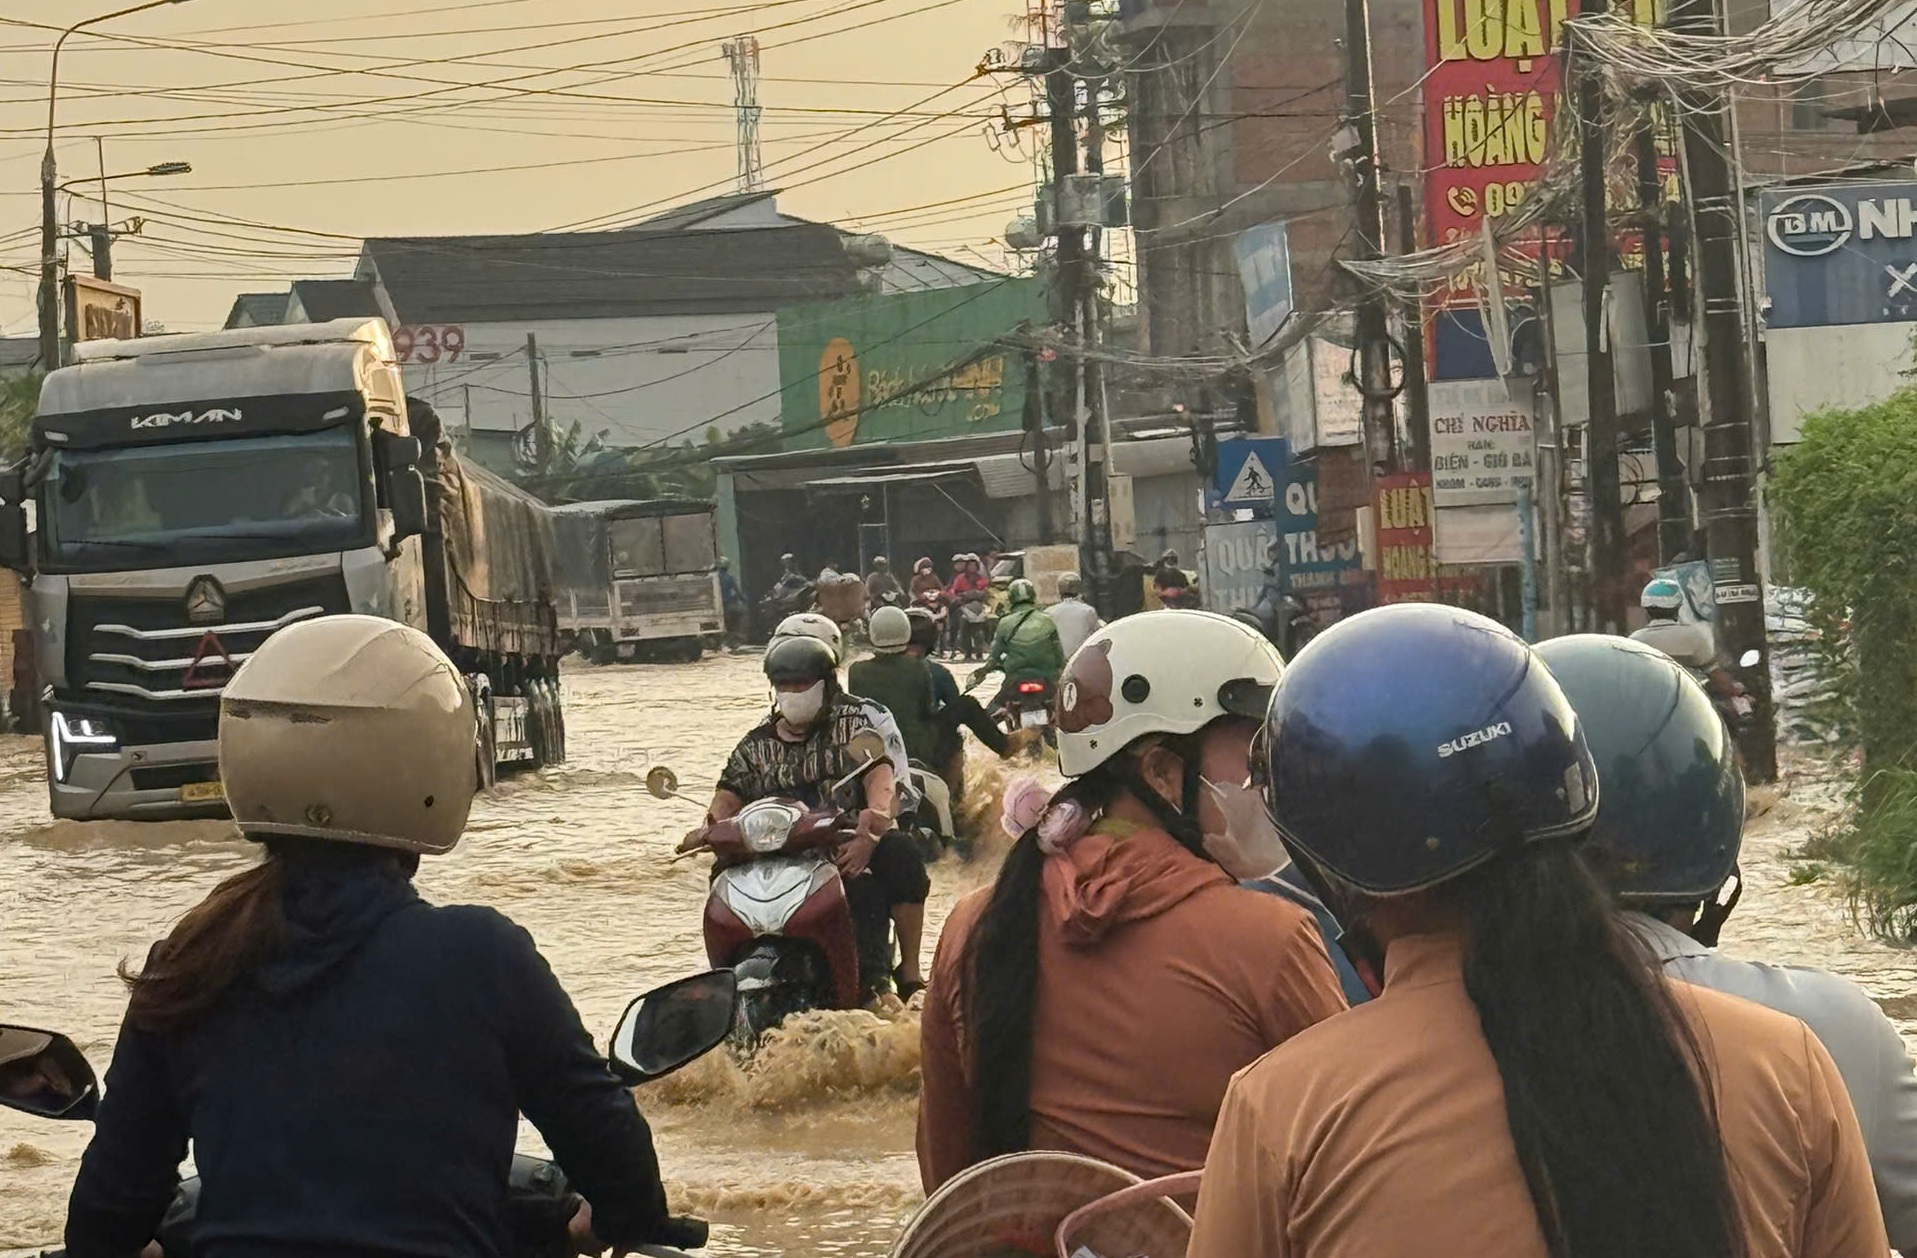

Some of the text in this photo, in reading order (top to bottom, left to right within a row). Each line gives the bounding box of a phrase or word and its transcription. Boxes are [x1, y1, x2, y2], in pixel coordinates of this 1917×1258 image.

[1443, 83, 1547, 168] HOÀNG
[393, 325, 465, 363] 939
[1472, 410, 1531, 432] NGHĨA
[1437, 721, 1512, 758] SUZUKI
